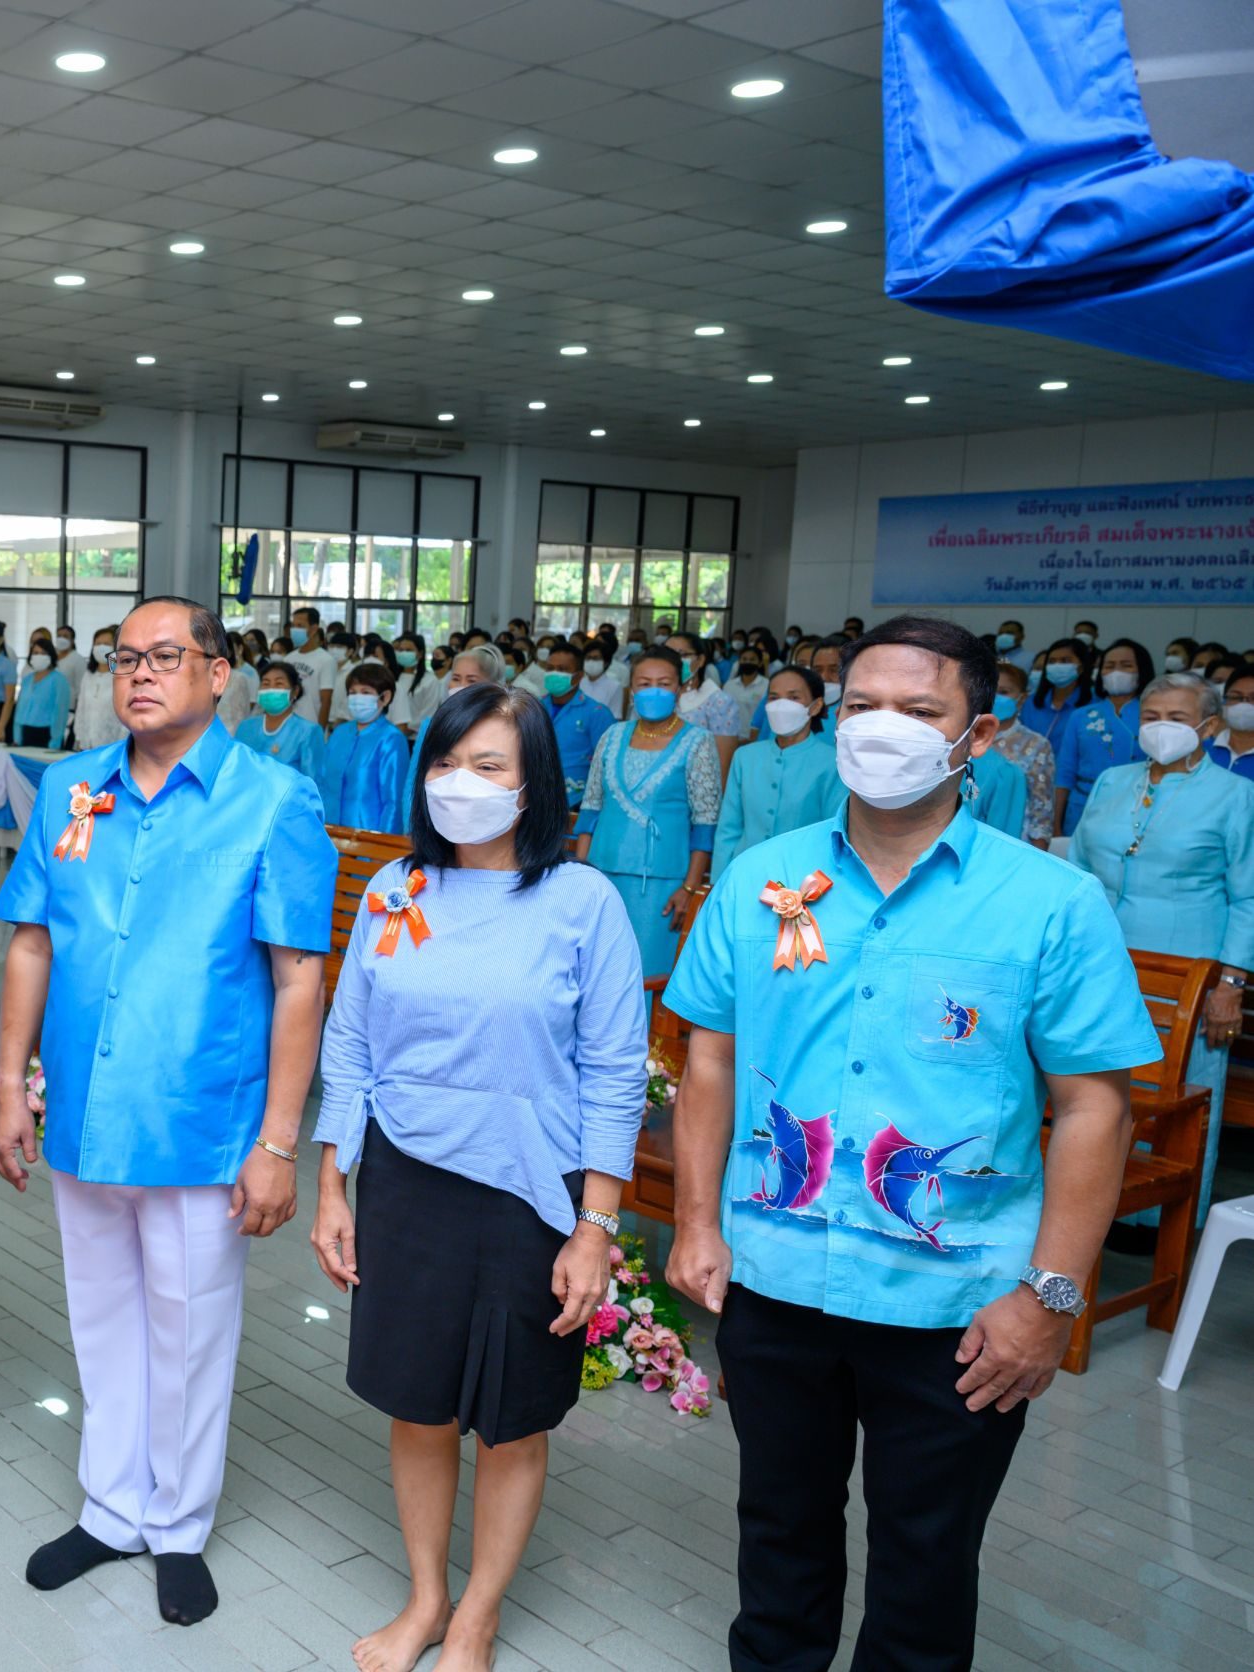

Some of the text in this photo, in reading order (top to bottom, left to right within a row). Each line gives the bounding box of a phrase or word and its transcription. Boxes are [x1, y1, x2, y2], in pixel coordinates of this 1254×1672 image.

[928, 522, 1090, 547] เพื่อเฉลิมพระเกียรติ
[986, 572, 1059, 591] วันอังคารที่
[1092, 578, 1144, 596] ตุลาคม
[1150, 577, 1185, 591] พ.ศ.
[1191, 576, 1246, 591] ๒๕๖๕
